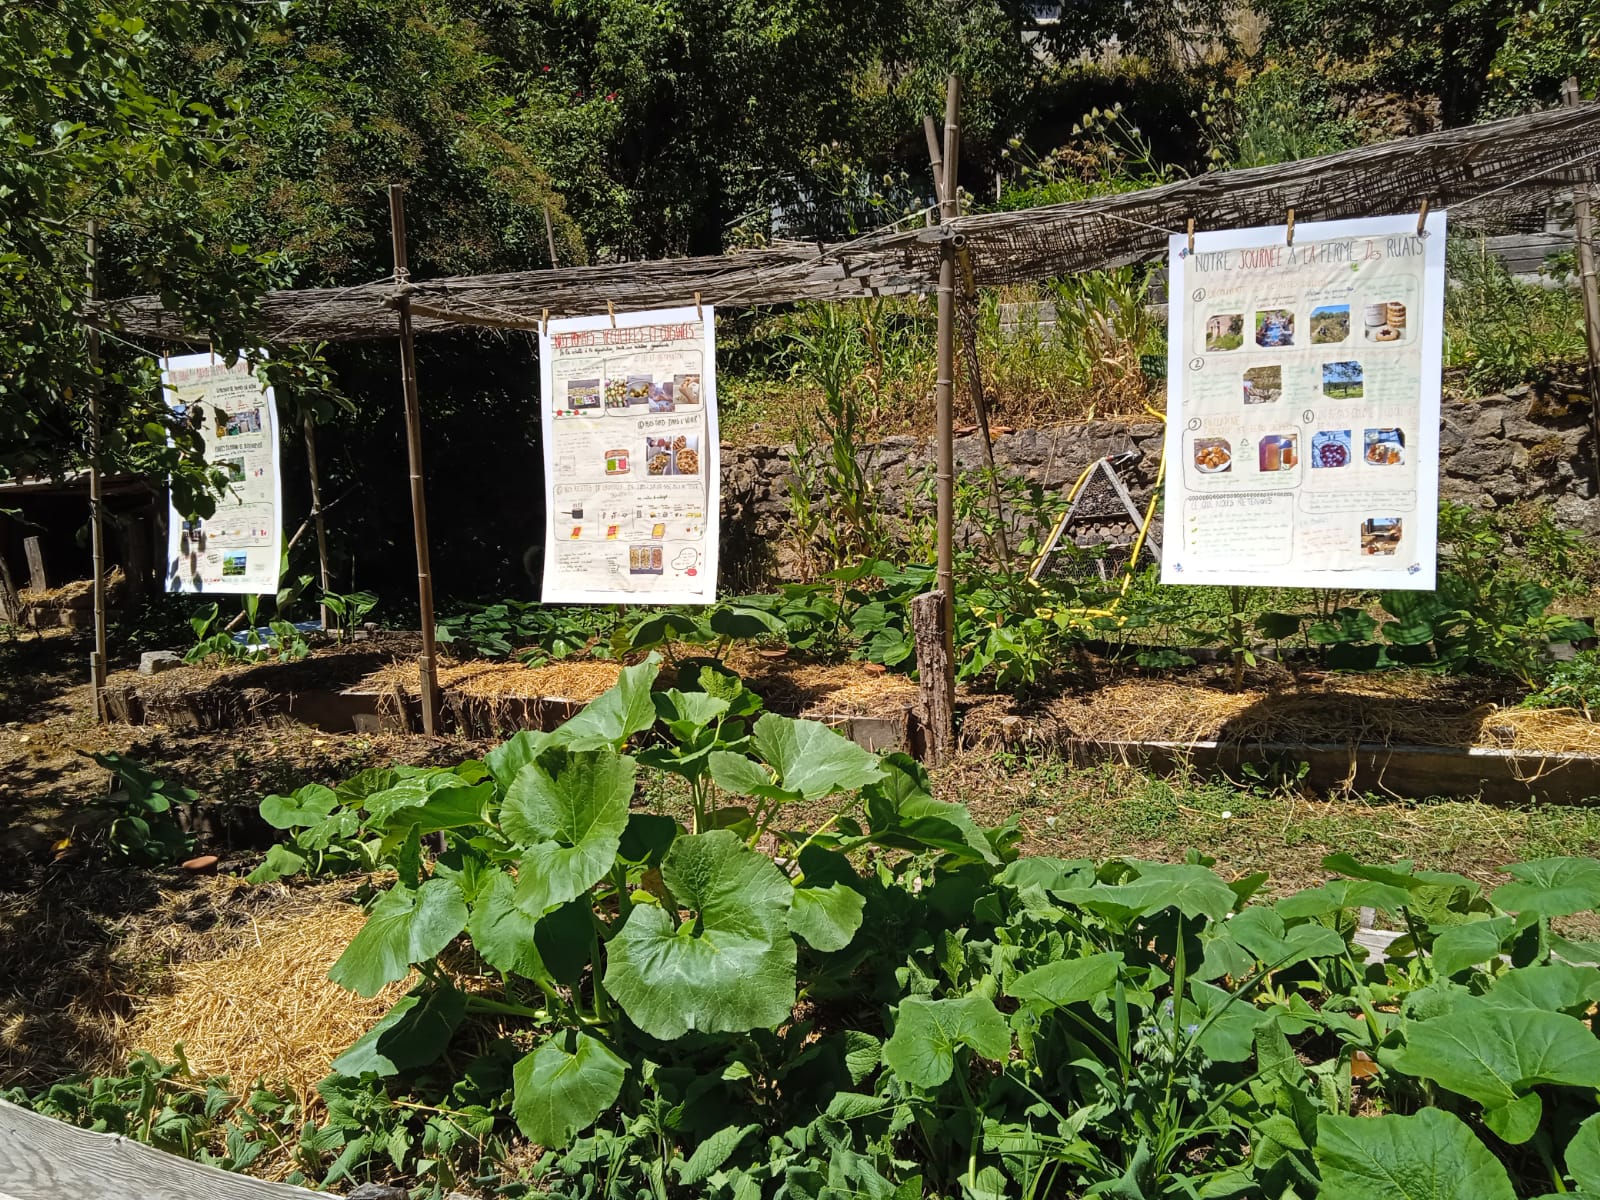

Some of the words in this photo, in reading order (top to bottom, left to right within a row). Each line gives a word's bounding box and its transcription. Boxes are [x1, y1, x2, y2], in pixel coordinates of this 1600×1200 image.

[1195, 251, 1232, 273] NOTRE
[1239, 244, 1284, 270] JOURNÉE
[1303, 245, 1316, 264] LA
[1320, 240, 1359, 263] FERME
[1387, 237, 1424, 258] RUATS
